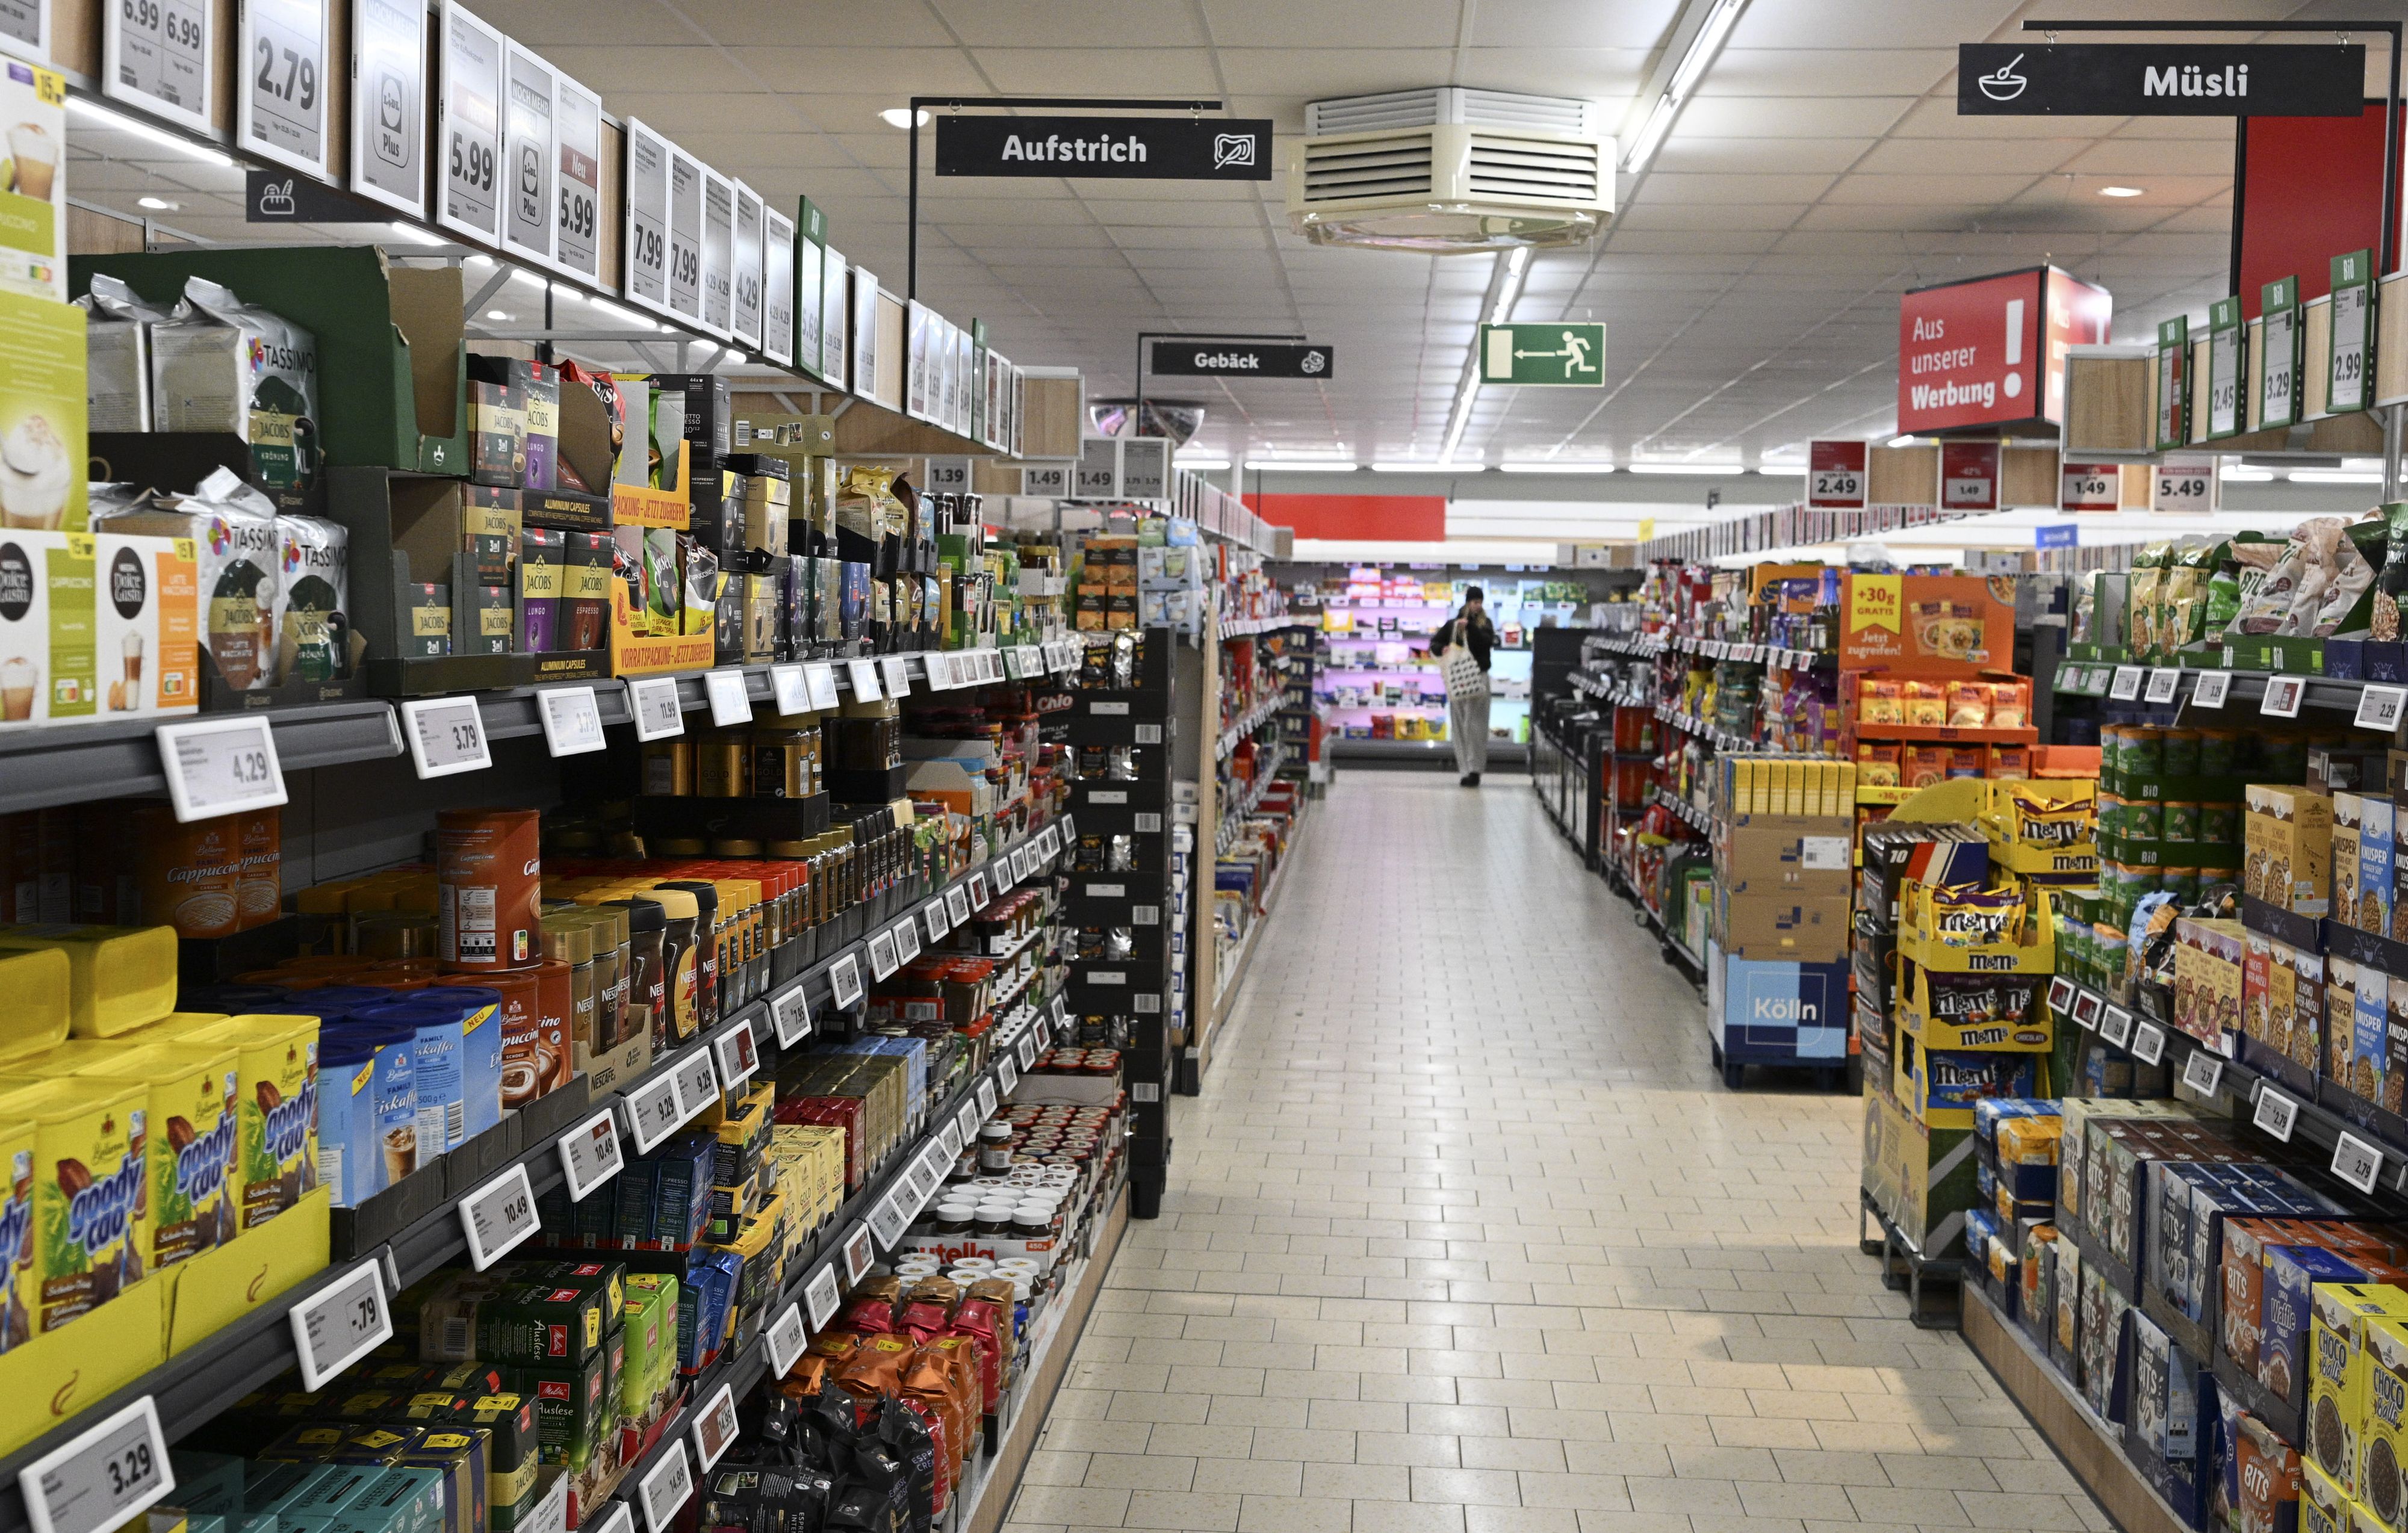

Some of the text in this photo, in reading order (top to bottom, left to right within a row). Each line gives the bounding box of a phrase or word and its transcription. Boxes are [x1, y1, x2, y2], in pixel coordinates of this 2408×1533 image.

[167, 12, 200, 50] 6.99
[258, 36, 315, 110] 2.79
[2144, 64, 2248, 97] Müsli
[513, 82, 548, 115] NOCH MEHR
[383, 133, 399, 158] Plus
[1001, 133, 1147, 162] Aufstrich
[452, 131, 493, 191] 5.99
[572, 153, 586, 180] Neu
[523, 200, 536, 218] Plus
[560, 187, 593, 238] 5.99
[636, 223, 663, 270] 7.99
[672, 243, 697, 286] 7.99
[718, 280, 729, 297] 4.29
[737, 271, 757, 310] 4.29
[780, 308, 789, 324] 4.29
[802, 308, 819, 344] 5.69
[1913, 317, 1944, 341] Aus
[263, 344, 315, 374] TASSIMO
[1194, 352, 1259, 370] Gebäck
[1911, 347, 1976, 375] unserer
[2335, 352, 2361, 382] 2.99
[1911, 381, 1995, 410] Werbung
[2267, 372, 2289, 400] 3.29
[2214, 385, 2234, 412] 2.45
[259, 421, 290, 439] JACOBS
[494, 415, 512, 429] JACOBS
[527, 442, 544, 451] LUNGO
[932, 468, 964, 482] 1.39
[1029, 471, 1061, 485] 1.49
[1079, 472, 1111, 485] 1.49
[1818, 479, 1857, 494] 2.49
[1960, 486, 1979, 495] 1.49
[2075, 482, 2106, 494] 1.49
[2160, 481, 2205, 497] 5.49
[545, 500, 590, 513] ALUMINIUM CAPSULES
[644, 499, 660, 518] JETZT
[660, 501, 685, 521] ZUGREIFEN
[485, 516, 506, 530] JACOBS
[525, 575, 551, 591] JACOBS
[579, 577, 602, 591] JACOBS
[1857, 588, 1894, 604] +30g
[700, 616, 706, 625] 16
[1857, 607, 1893, 616] GRATIS
[420, 616, 444, 629] JACOBS
[486, 618, 507, 630] JACOBS
[1861, 631, 1888, 644] Jetzt
[621, 643, 712, 668] VORRATSPACKUNG JETZT ZUGREIFEN
[1848, 643, 1901, 659] zugreifen!
[541, 660, 586, 671] ALUMINIUM CAPSULES
[660, 701, 675, 720] 11.99
[1036, 695, 1073, 711] Chio
[2380, 704, 2396, 719] 2.29
[453, 725, 477, 750] 3.79
[234, 752, 267, 783] 4.29
[1890, 850, 1908, 864] 10
[2362, 844, 2387, 864] KNUSPER
[847, 973, 857, 989] 6.49
[2298, 981, 2313, 998] SCHOKO
[794, 1006, 805, 1024] 7.95
[1755, 998, 1817, 1020] Kölln
[467, 1012, 485, 1028] NEU
[2356, 1011, 2382, 1031] KNUSPER
[420, 1035, 444, 1044] FAMILY
[2149, 1041, 2158, 1053] 1.59
[697, 1068, 712, 1094] 9.29
[2202, 1070, 2213, 1083] 2.79
[659, 1095, 674, 1122] 9.29
[2274, 1112, 2287, 1128] 2.79
[177, 1115, 236, 1194] goody
[595, 1138, 613, 1163] 10.49
[922, 1167, 932, 1183] 12.99
[2355, 1160, 2371, 1177] 2.79
[662, 1177, 688, 1185] ESPRESSO
[70, 1156, 143, 1243] goody
[799, 1189, 811, 1209] GOLD
[906, 1188, 916, 1205] 12.99
[2114, 1186, 2131, 1216] BITS
[504, 1195, 528, 1224] 10.49
[889, 1210, 899, 1227] 11.99
[2163, 1212, 2179, 1241] BITS
[824, 1282, 836, 1301] 12.99
[2227, 1266, 2247, 1299] BITS
[2271, 1297, 2295, 1328] Waffle
[788, 1328, 801, 1345] 11.99
[2318, 1329, 2346, 1370] CHOCO
[2138, 1358, 2157, 1390] BITS
[2372, 1364, 2404, 1412] CHOCO
[539, 1403, 574, 1416] Auslese
[718, 1410, 733, 1433] 14.95
[108, 1443, 152, 1493] 3.29
[514, 1461, 538, 1495] JACOBS
[300, 1469, 351, 1508] KAFFEEFILTER
[669, 1467, 686, 1493] 14.99
[2245, 1463, 2270, 1502] BITS
[353, 1472, 405, 1511] KAFFEEFILTER
